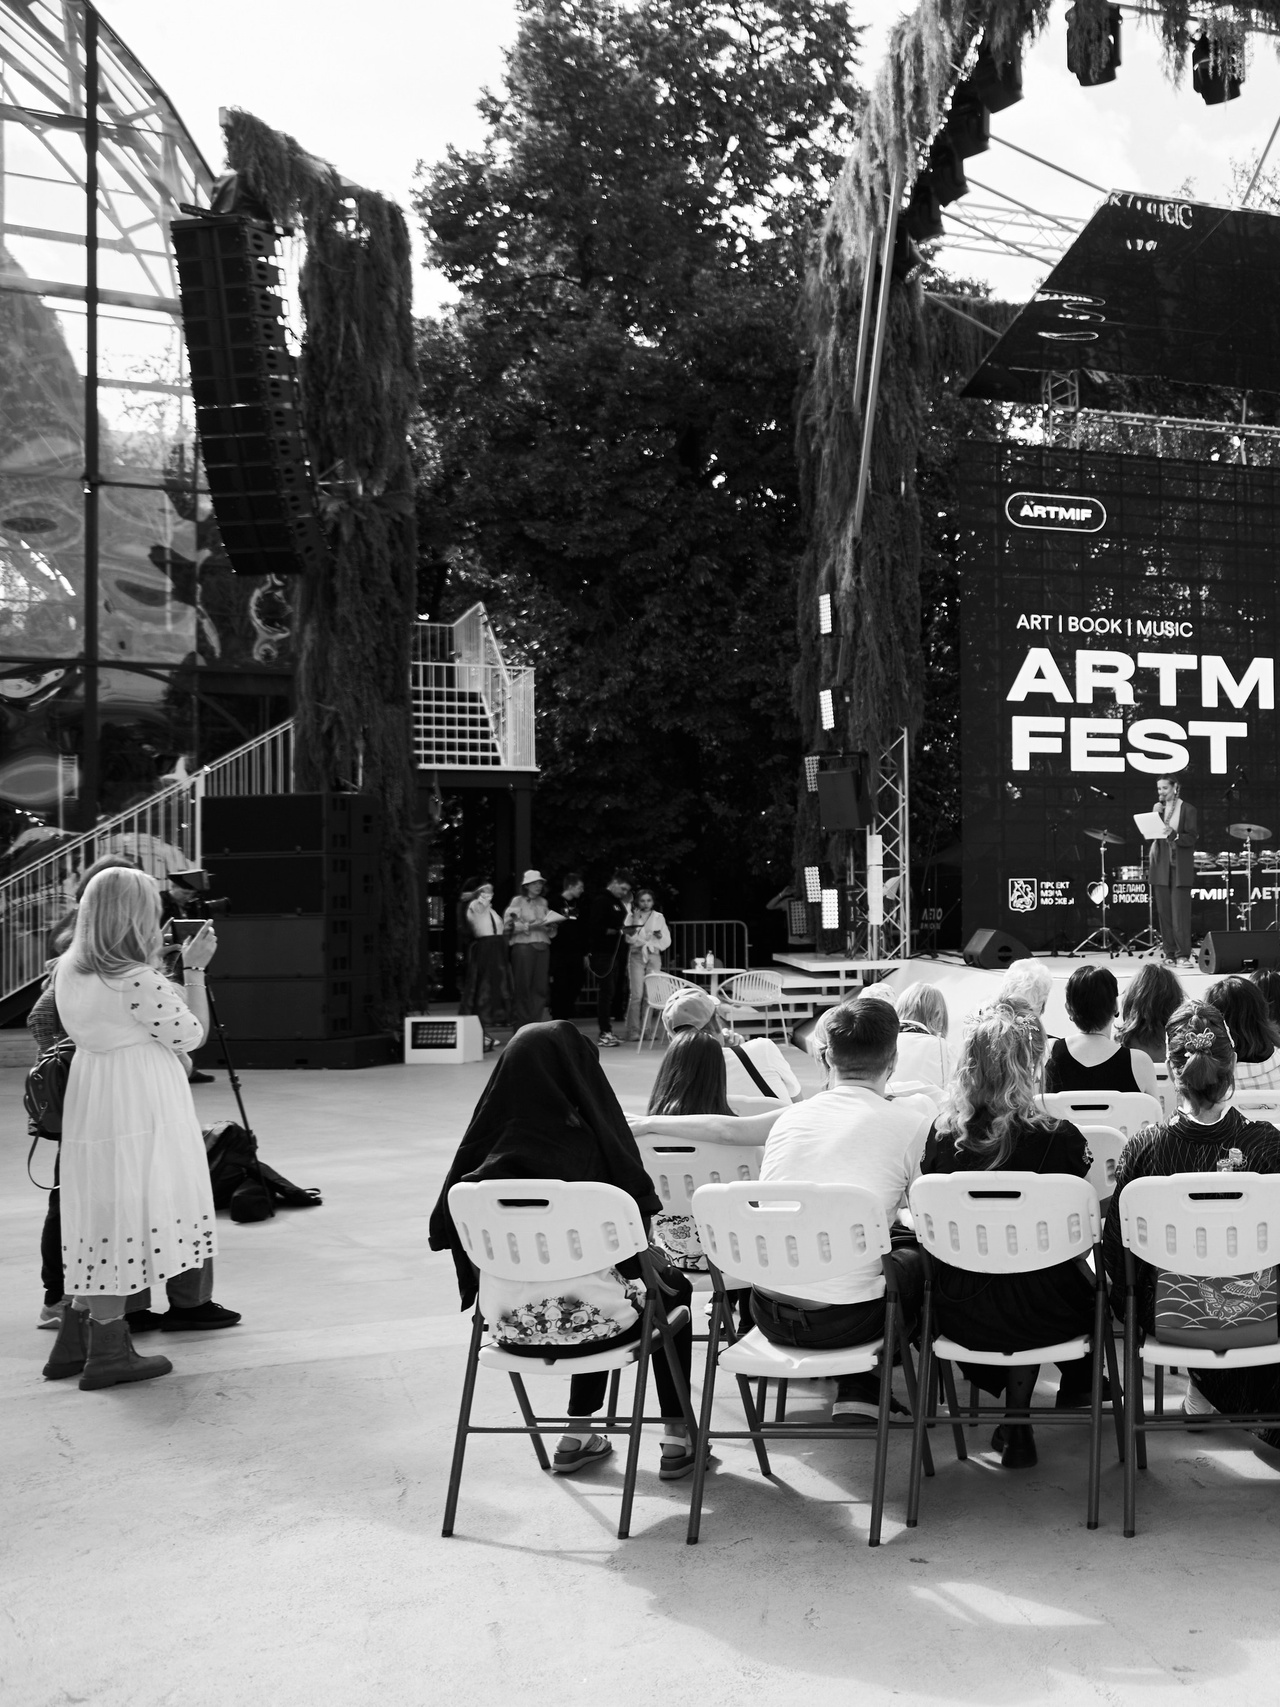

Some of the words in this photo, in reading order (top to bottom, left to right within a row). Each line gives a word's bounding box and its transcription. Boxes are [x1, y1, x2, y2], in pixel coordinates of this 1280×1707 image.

[1020, 504, 1093, 521] ARTMIF
[1016, 613, 1053, 631] ART
[1067, 616, 1122, 634] BOOK
[1136, 619, 1193, 638] MUSIC
[1011, 715, 1248, 775] FEST
[1112, 883, 1146, 894] СДЕЛАНО
[1118, 894, 1149, 903] МОСКВЕ
